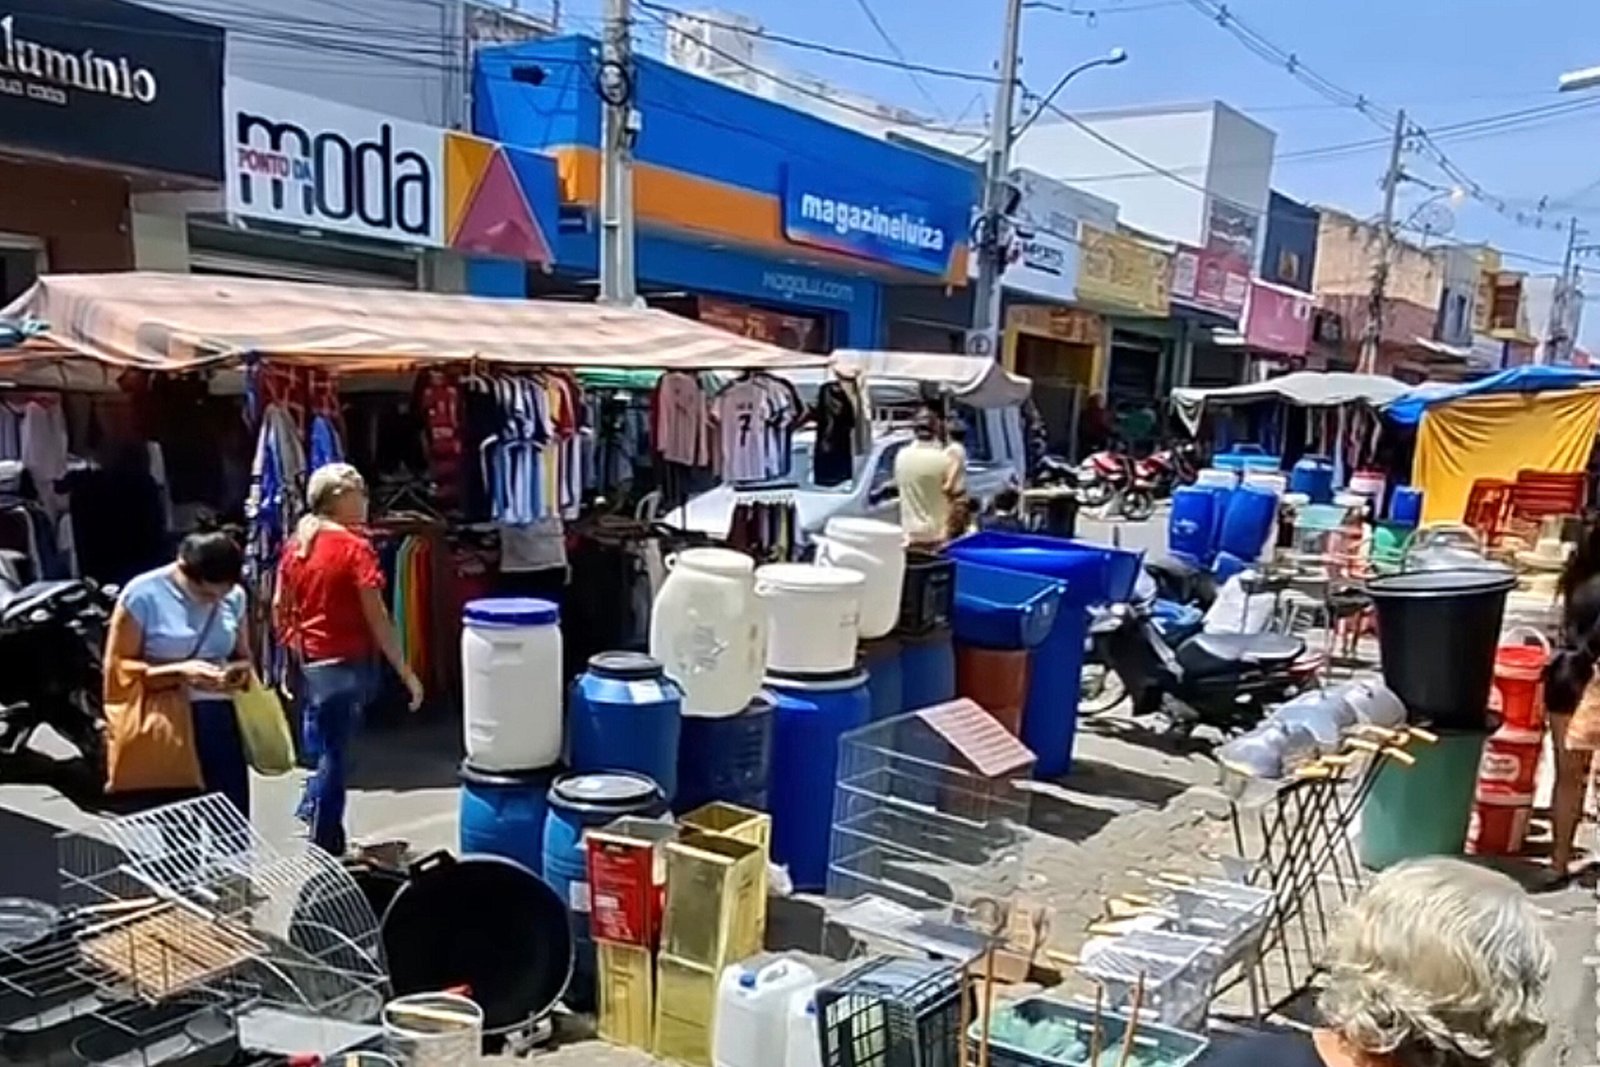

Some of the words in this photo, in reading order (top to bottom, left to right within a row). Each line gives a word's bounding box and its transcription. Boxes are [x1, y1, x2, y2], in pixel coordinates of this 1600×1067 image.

[0, 15, 156, 102] lumínio
[237, 111, 430, 237] moda
[238, 148, 289, 177] PONTO
[294, 158, 312, 181] DA
[801, 194, 944, 250] magazineluiza
[738, 412, 751, 447] 7
